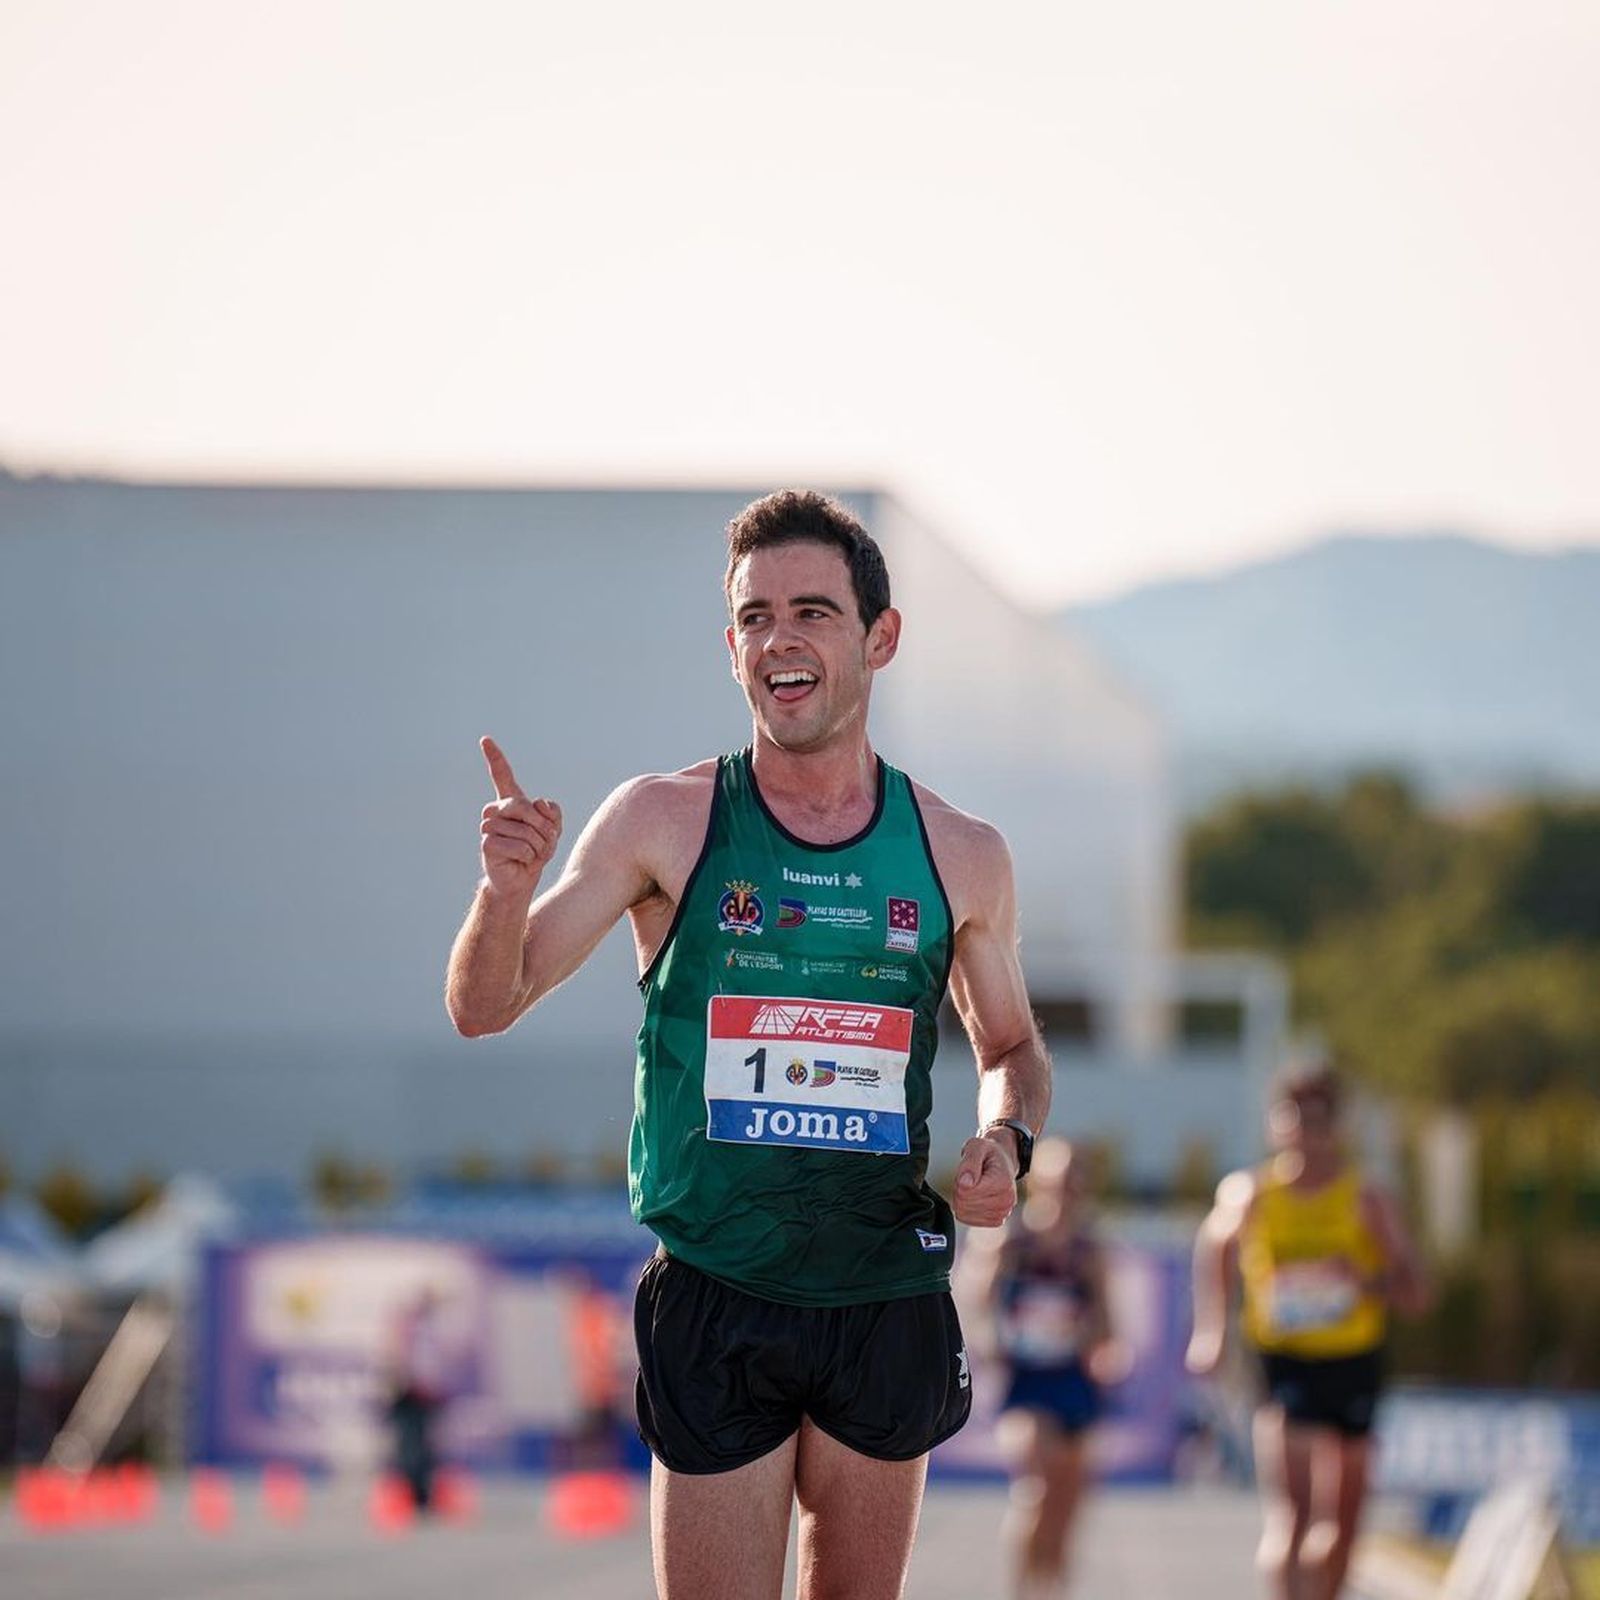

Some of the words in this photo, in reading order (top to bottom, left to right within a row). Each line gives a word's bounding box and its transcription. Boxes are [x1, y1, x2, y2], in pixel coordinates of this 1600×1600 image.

[783, 867, 840, 886] luanvi
[800, 1006, 882, 1029] RFEA
[795, 1026, 875, 1040] ATLETISMO
[744, 1047, 767, 1094] 1
